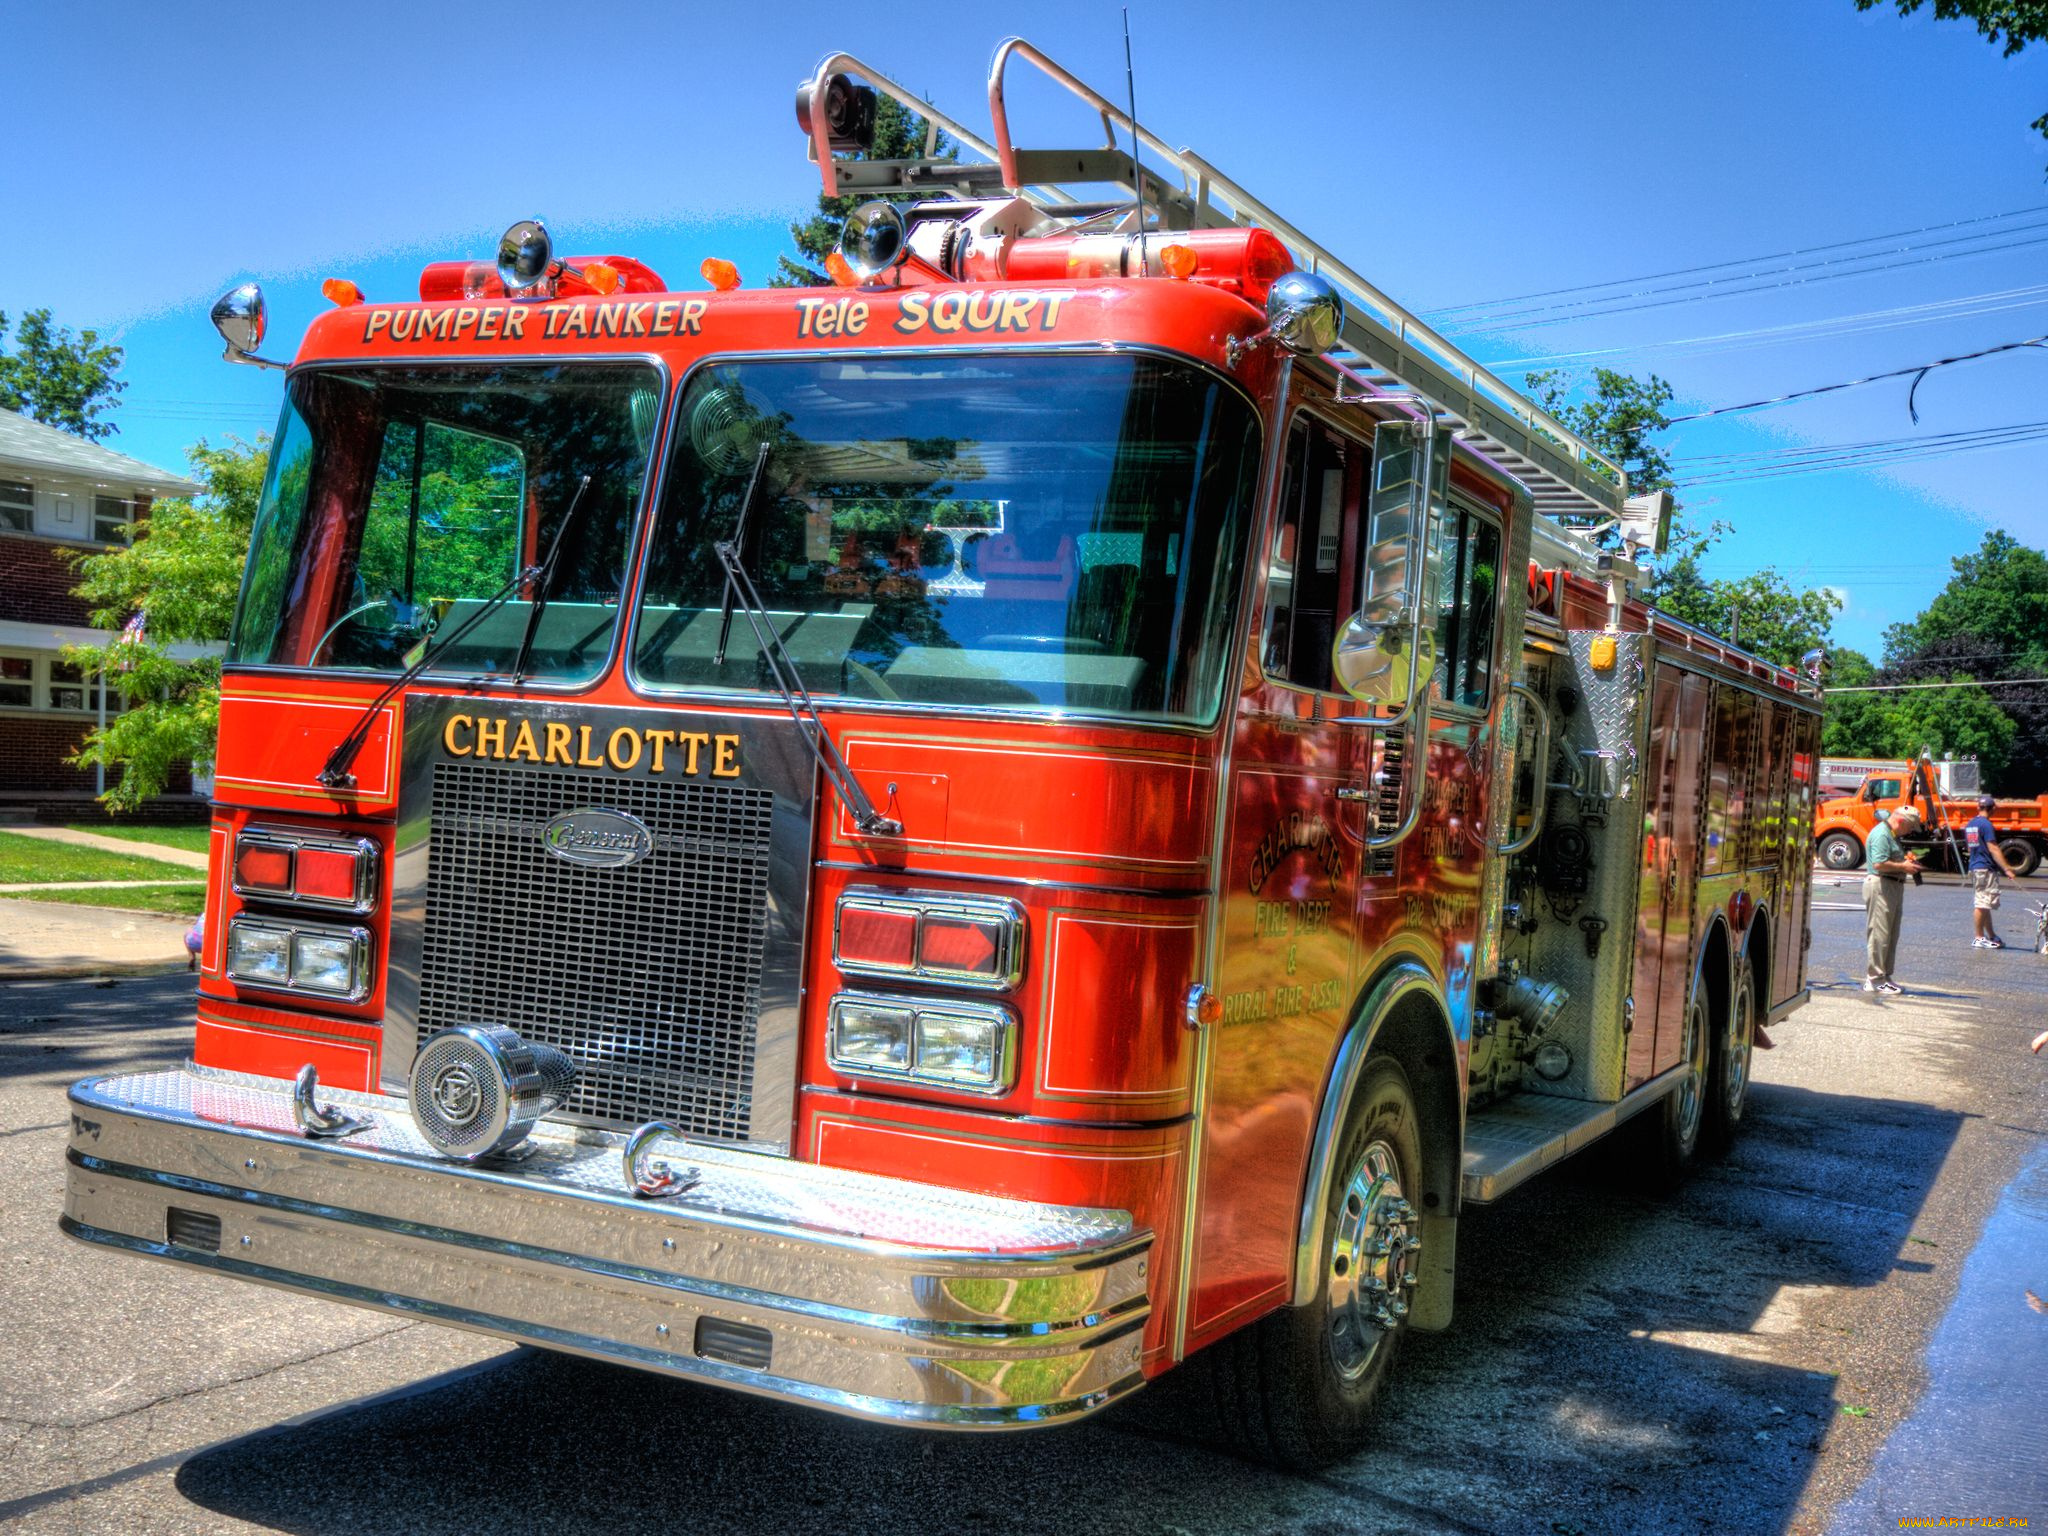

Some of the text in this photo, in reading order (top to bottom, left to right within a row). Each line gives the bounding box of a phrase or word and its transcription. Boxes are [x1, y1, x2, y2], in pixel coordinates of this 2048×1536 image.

[362, 299, 708, 344] PUMPER TANKER
[795, 288, 1077, 339] Tele SQURT
[443, 713, 744, 779] CHARLOTTE
[1423, 779, 1471, 813] PUMPER
[557, 823, 641, 850] General
[1249, 810, 1342, 896] CHARLOTTE
[1423, 826, 1466, 857] TANKER
[1254, 900, 1331, 938] FIRE DEPT
[1405, 892, 1468, 929] Tele SQURT
[1286, 944, 1297, 976] &
[1223, 979, 1341, 1028] RURAL FIRE ASSN
